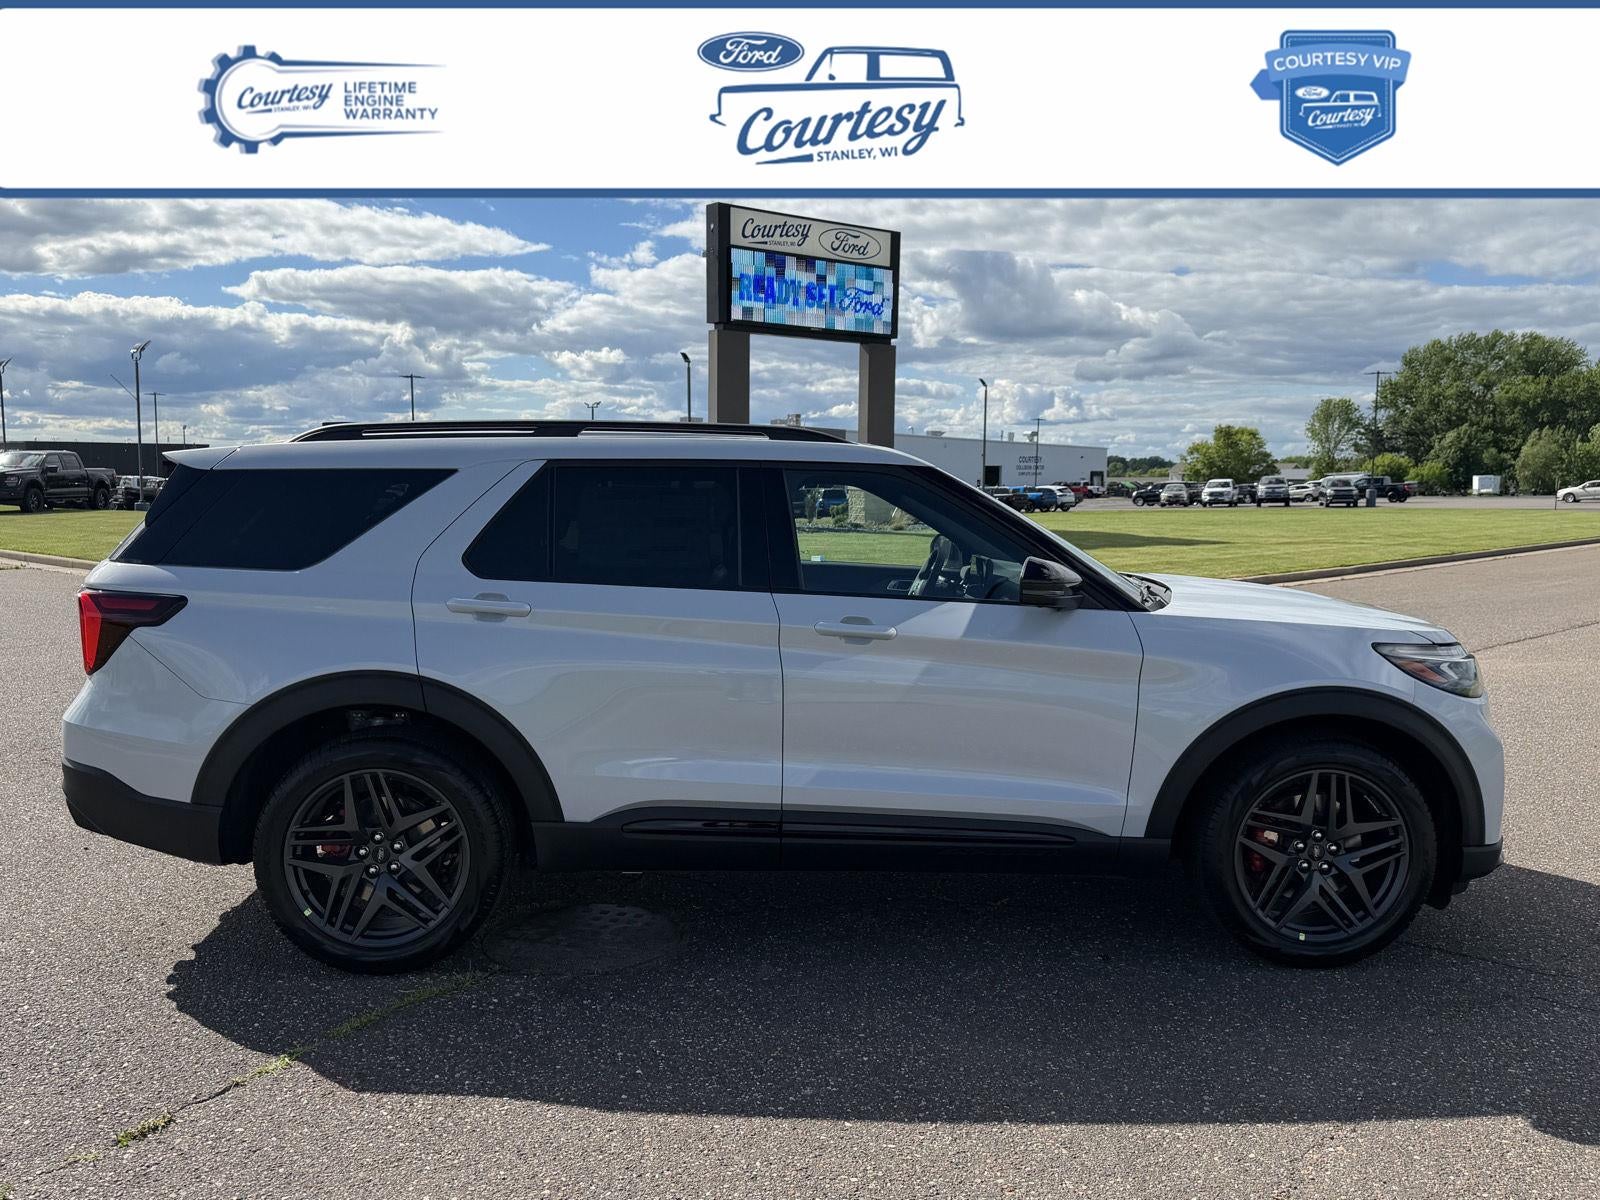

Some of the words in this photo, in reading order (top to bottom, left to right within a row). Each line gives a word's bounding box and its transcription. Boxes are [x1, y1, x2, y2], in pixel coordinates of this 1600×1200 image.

[741, 217, 812, 247] Courtesy
[830, 230, 870, 257] Ford
[838, 286, 890, 316] Ford
